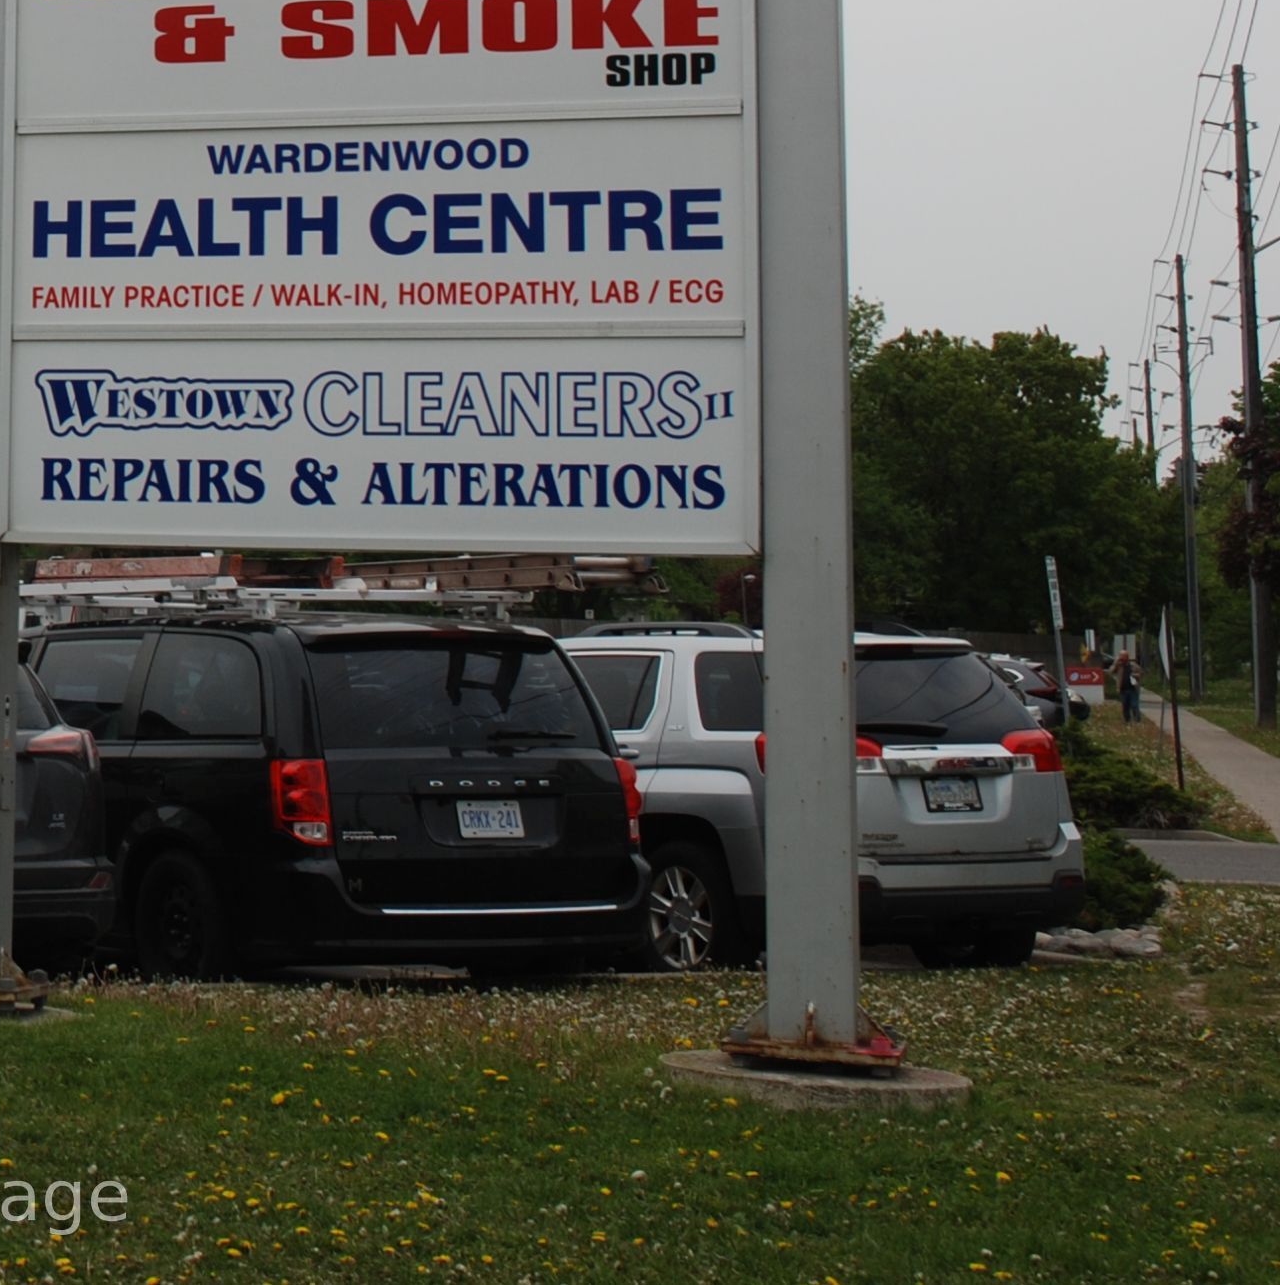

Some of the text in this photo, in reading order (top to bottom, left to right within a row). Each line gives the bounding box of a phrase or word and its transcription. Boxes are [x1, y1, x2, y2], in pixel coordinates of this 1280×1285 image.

[153, 4, 235, 64] &
[605, 52, 717, 88] SHOP
[206, 137, 531, 176] WARDENWOOD
[31, 188, 725, 259] HEALTH CENTRE
[31, 285, 115, 310] FAMILY
[124, 284, 246, 309] PRACTICE
[270, 283, 388, 311] WALK-IN,
[397, 279, 580, 309] HOMEOPATHY,
[590, 280, 641, 306] LAB
[668, 279, 725, 305] ECG
[303, 370, 704, 439] CLEANERS
[40, 457, 727, 510] REPAIRS & ALTERATIONS
[461, 808, 520, 830] CRKX 241
